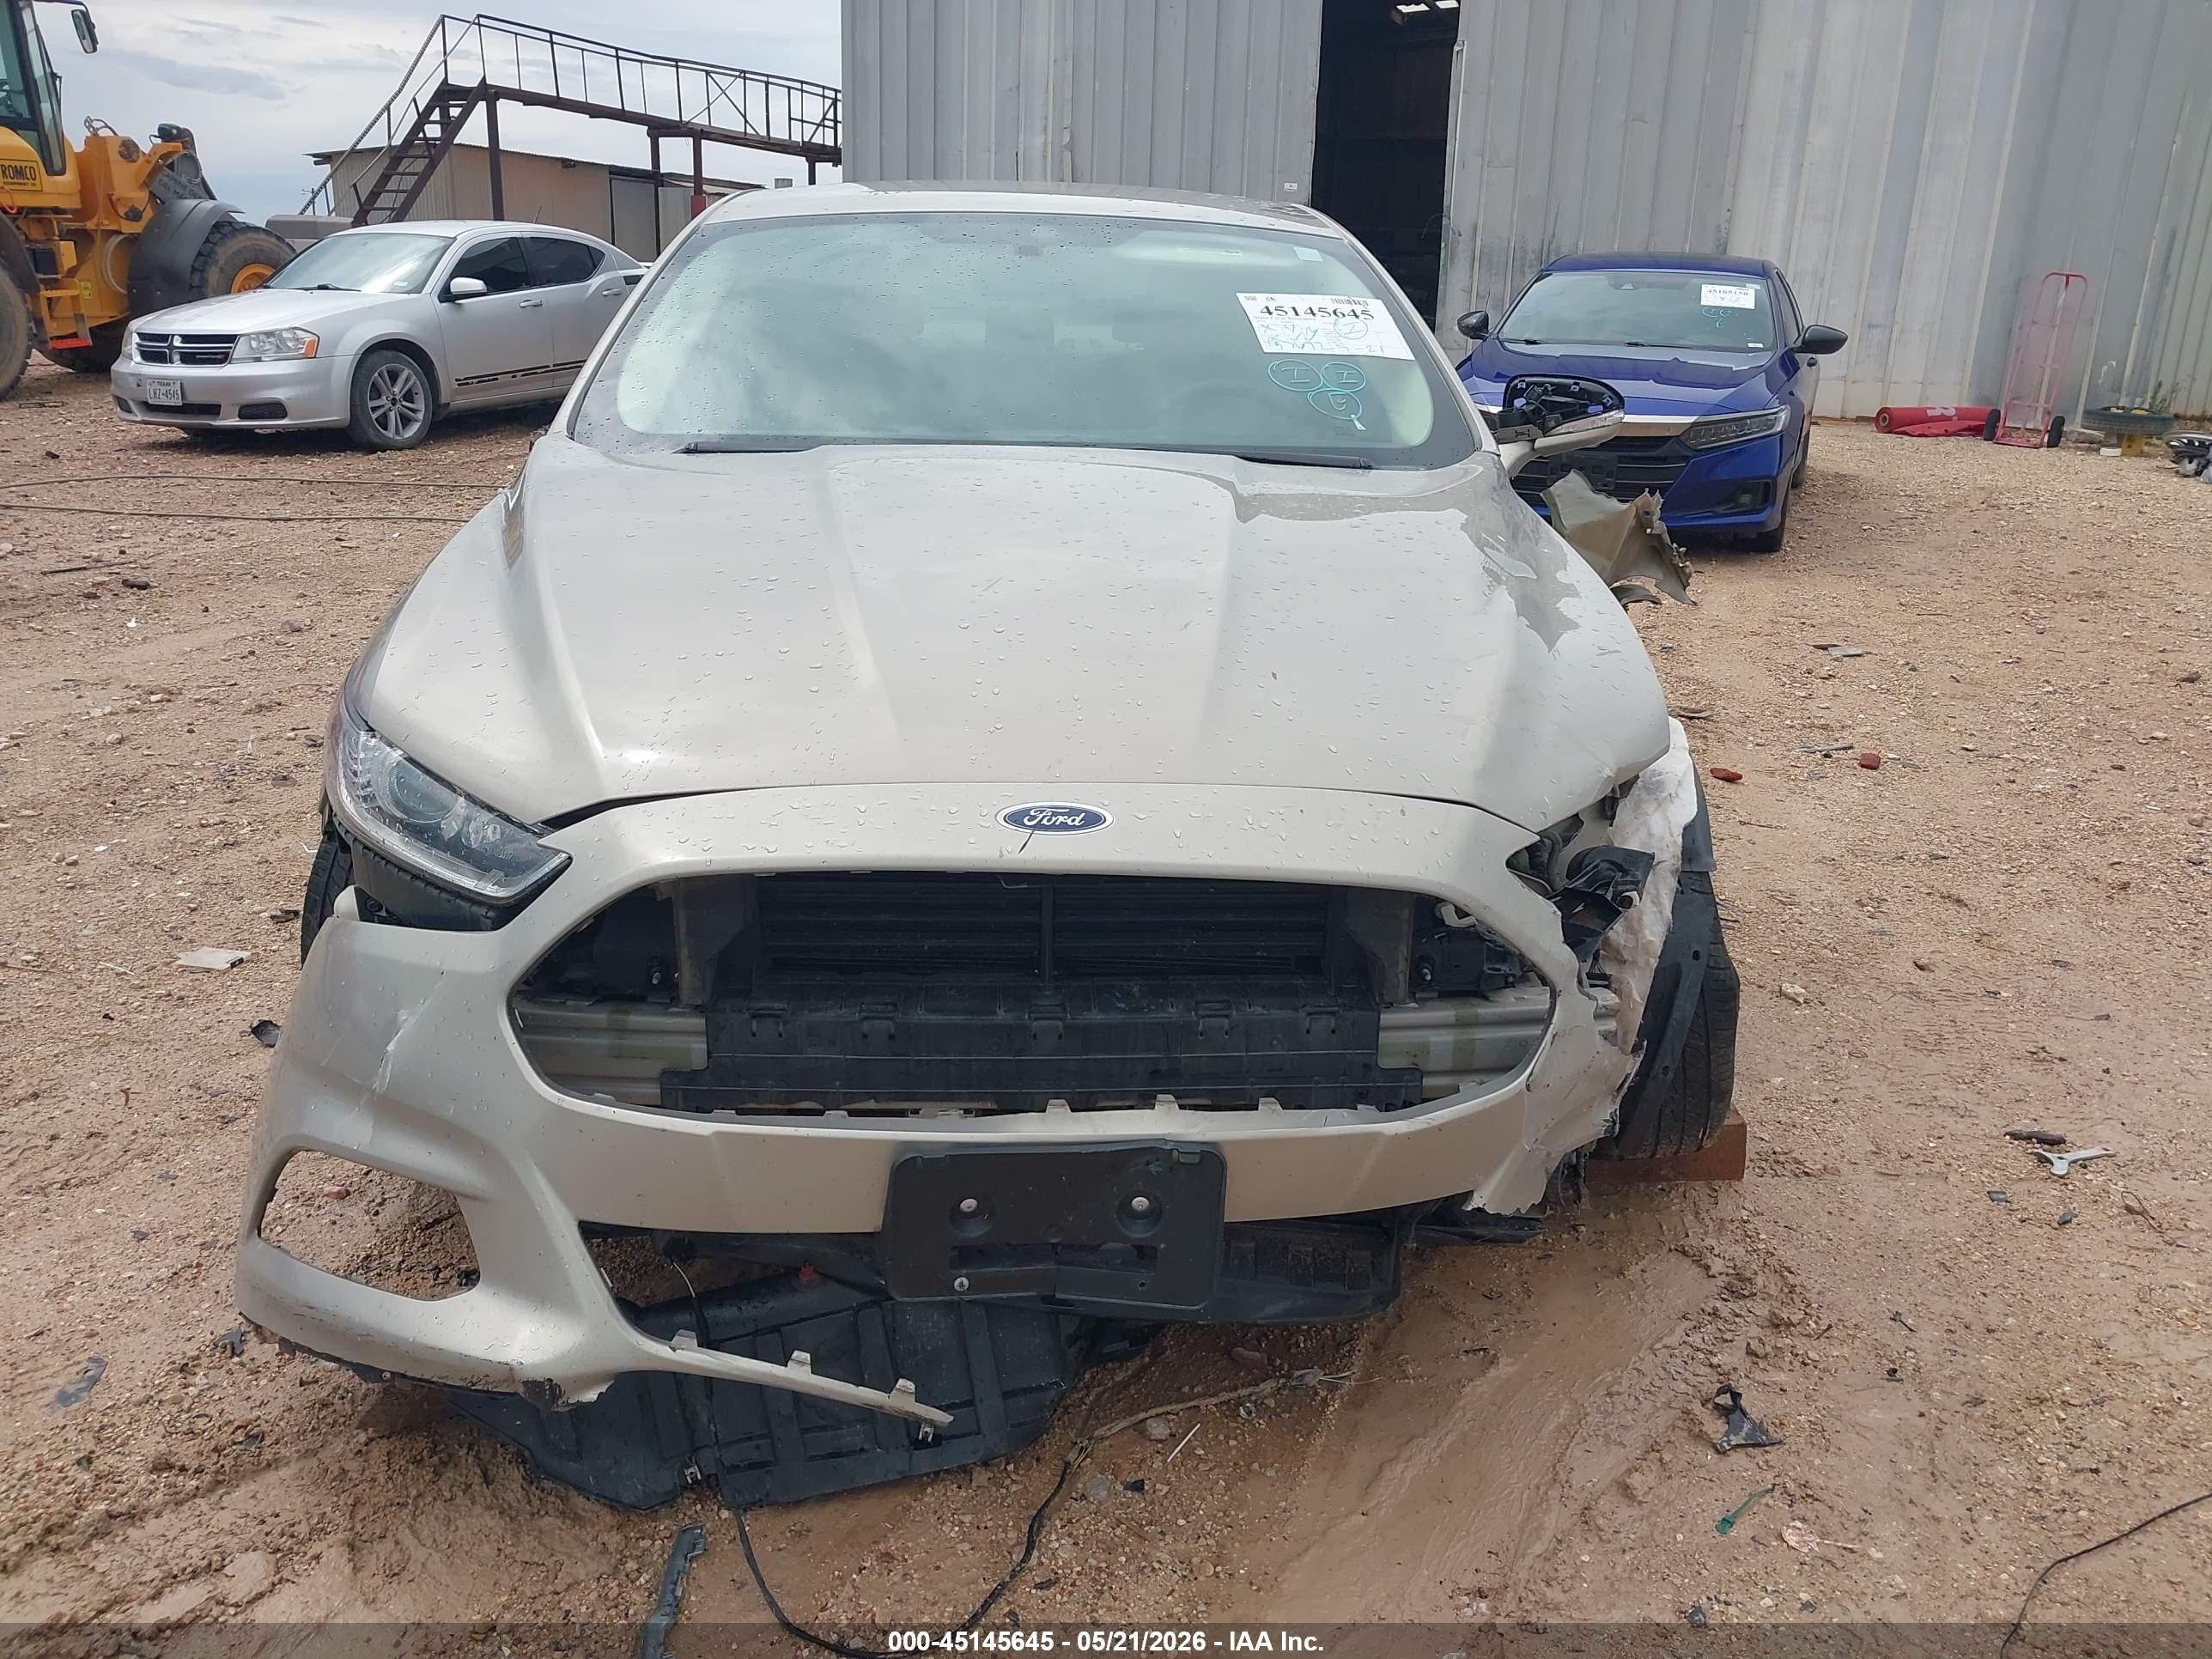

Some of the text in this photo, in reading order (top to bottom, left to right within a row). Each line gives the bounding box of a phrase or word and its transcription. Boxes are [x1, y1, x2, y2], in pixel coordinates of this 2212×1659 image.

[0, 164, 37, 181] ROMCO
[1260, 305, 1375, 320] 45145645
[1023, 807, 1086, 826] Ford
